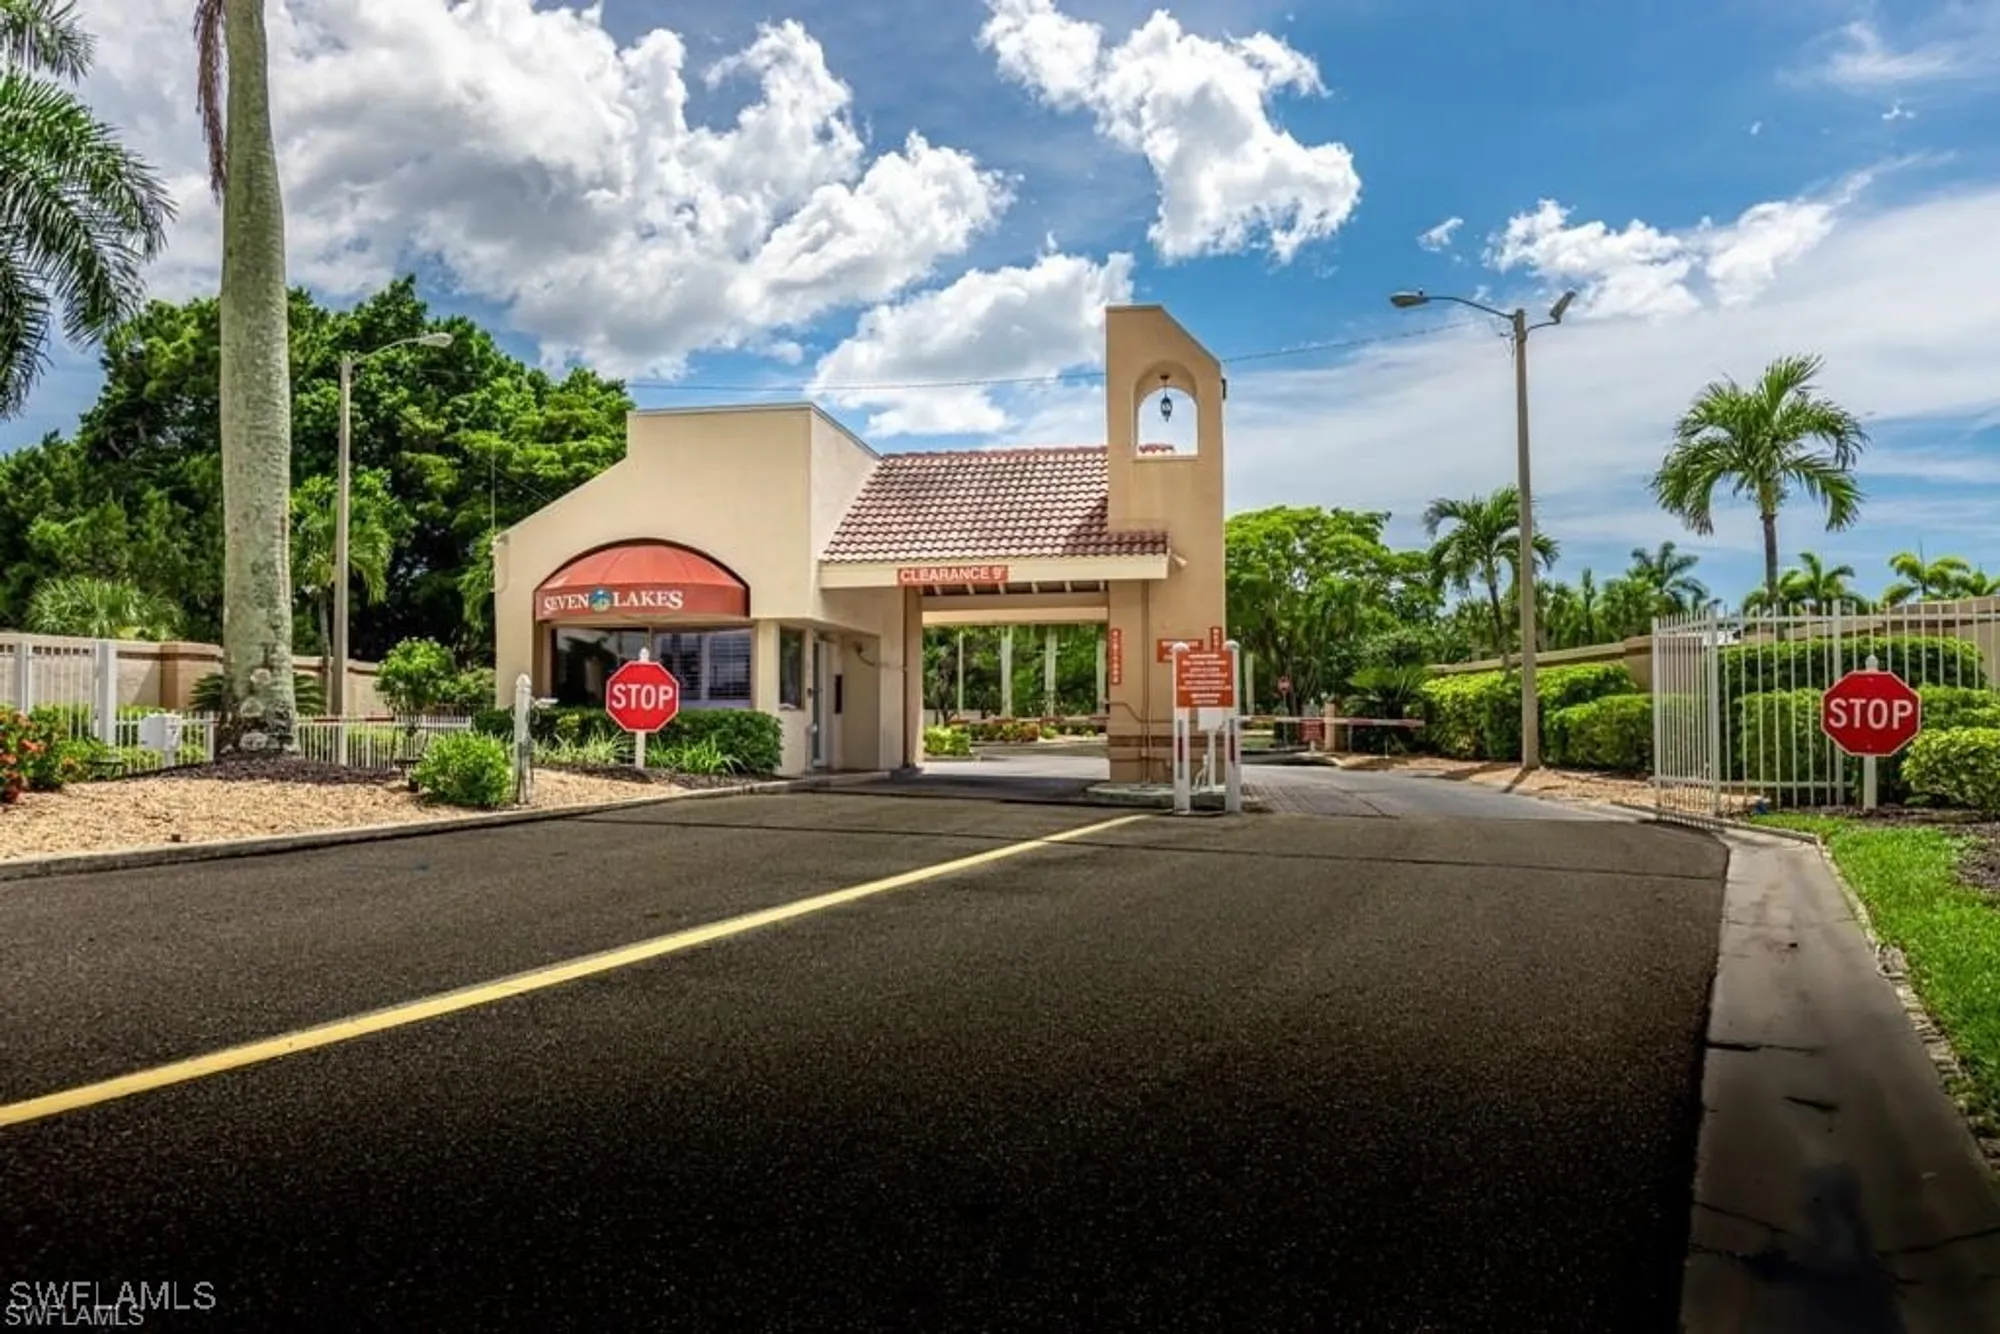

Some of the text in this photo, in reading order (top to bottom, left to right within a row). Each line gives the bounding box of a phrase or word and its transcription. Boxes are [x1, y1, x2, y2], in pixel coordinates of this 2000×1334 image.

[900, 566, 990, 582] CLEARANCE
[543, 590, 684, 615] SEVEN LAKES
[611, 683, 674, 711] STOP
[1828, 698, 1913, 730] STOP
